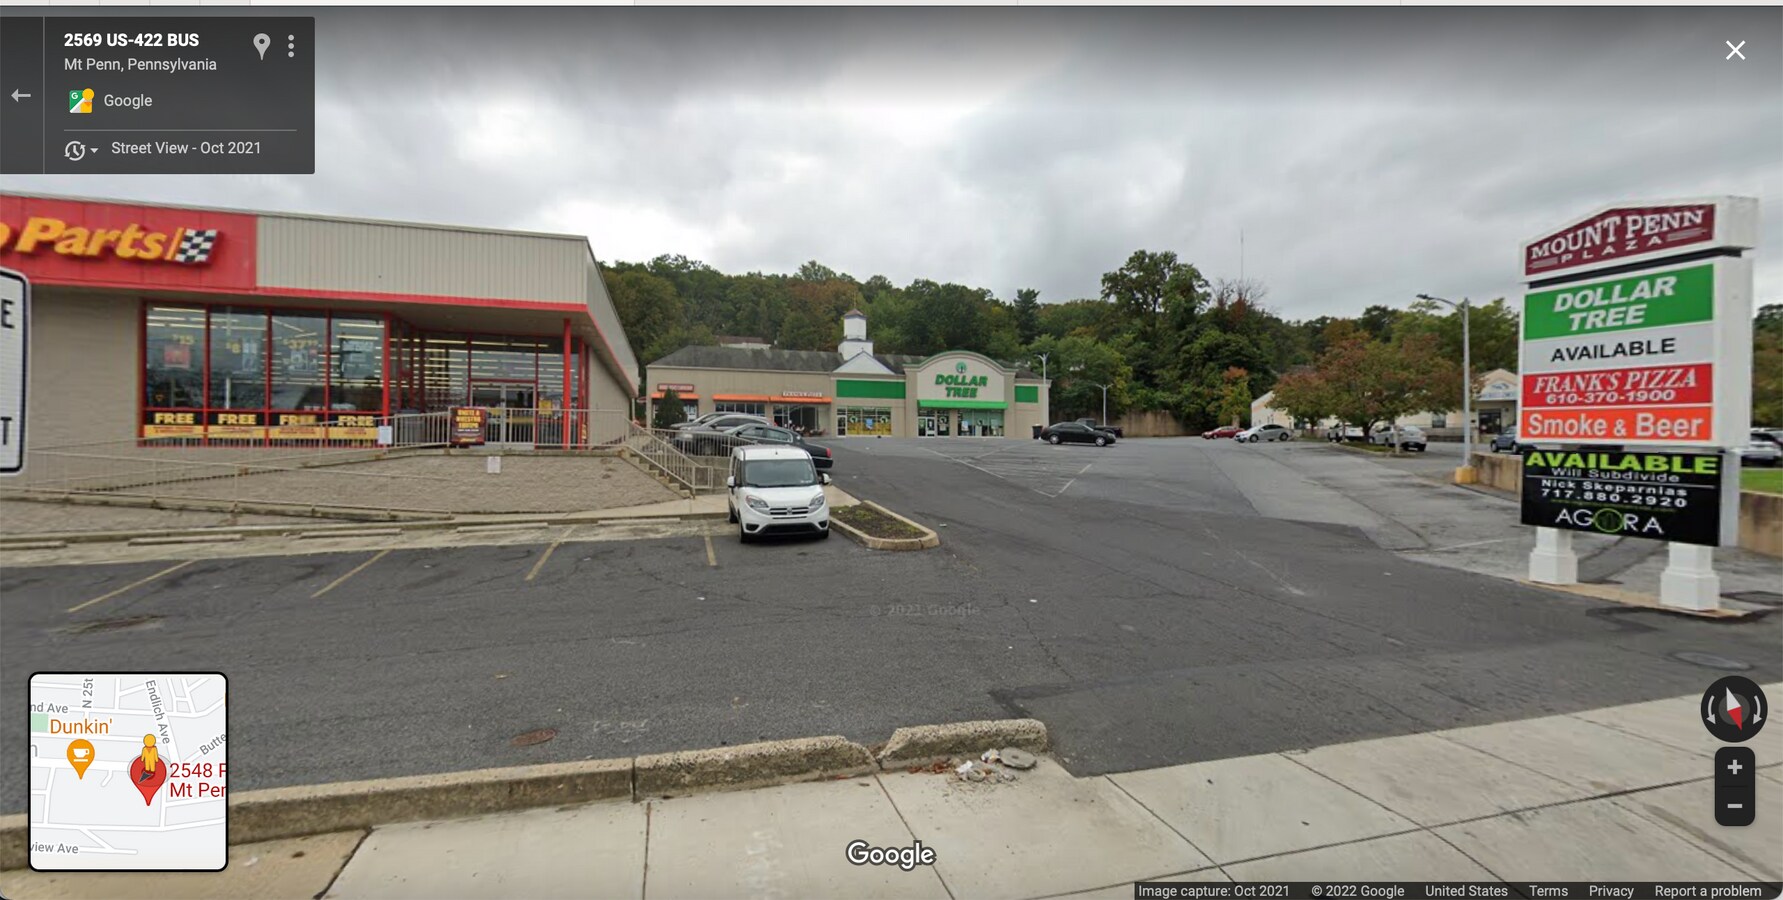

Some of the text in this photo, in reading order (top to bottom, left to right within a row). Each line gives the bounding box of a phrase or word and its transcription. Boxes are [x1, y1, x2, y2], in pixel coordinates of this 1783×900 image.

[15, 216, 167, 260] Parts
[1530, 209, 1704, 259] MOUNT PENN
[1561, 235, 1663, 263] PLAZA
[1554, 276, 1677, 312] DOLLAR
[1569, 304, 1647, 331] TREE
[1551, 338, 1677, 362] AVAILABLE
[935, 374, 988, 387] DOLLAR
[1533, 368, 1697, 393] FRANK'S PIZZA
[945, 387, 978, 398] TREE
[1546, 389, 1676, 405] 610-370-1900
[154, 412, 195, 424] FREE
[217, 413, 257, 425] FREE
[279, 414, 317, 426] FREE
[337, 415, 374, 427] FREE
[1528, 412, 1704, 437] Smoke & Beer
[1526, 452, 1718, 474] AVAILABLE
[1551, 467, 1680, 483] Will Subdivide
[1541, 479, 1688, 497] Nick Skeparnias
[1541, 488, 1688, 508] 717.880.2920
[1555, 507, 1665, 534] AGORA
